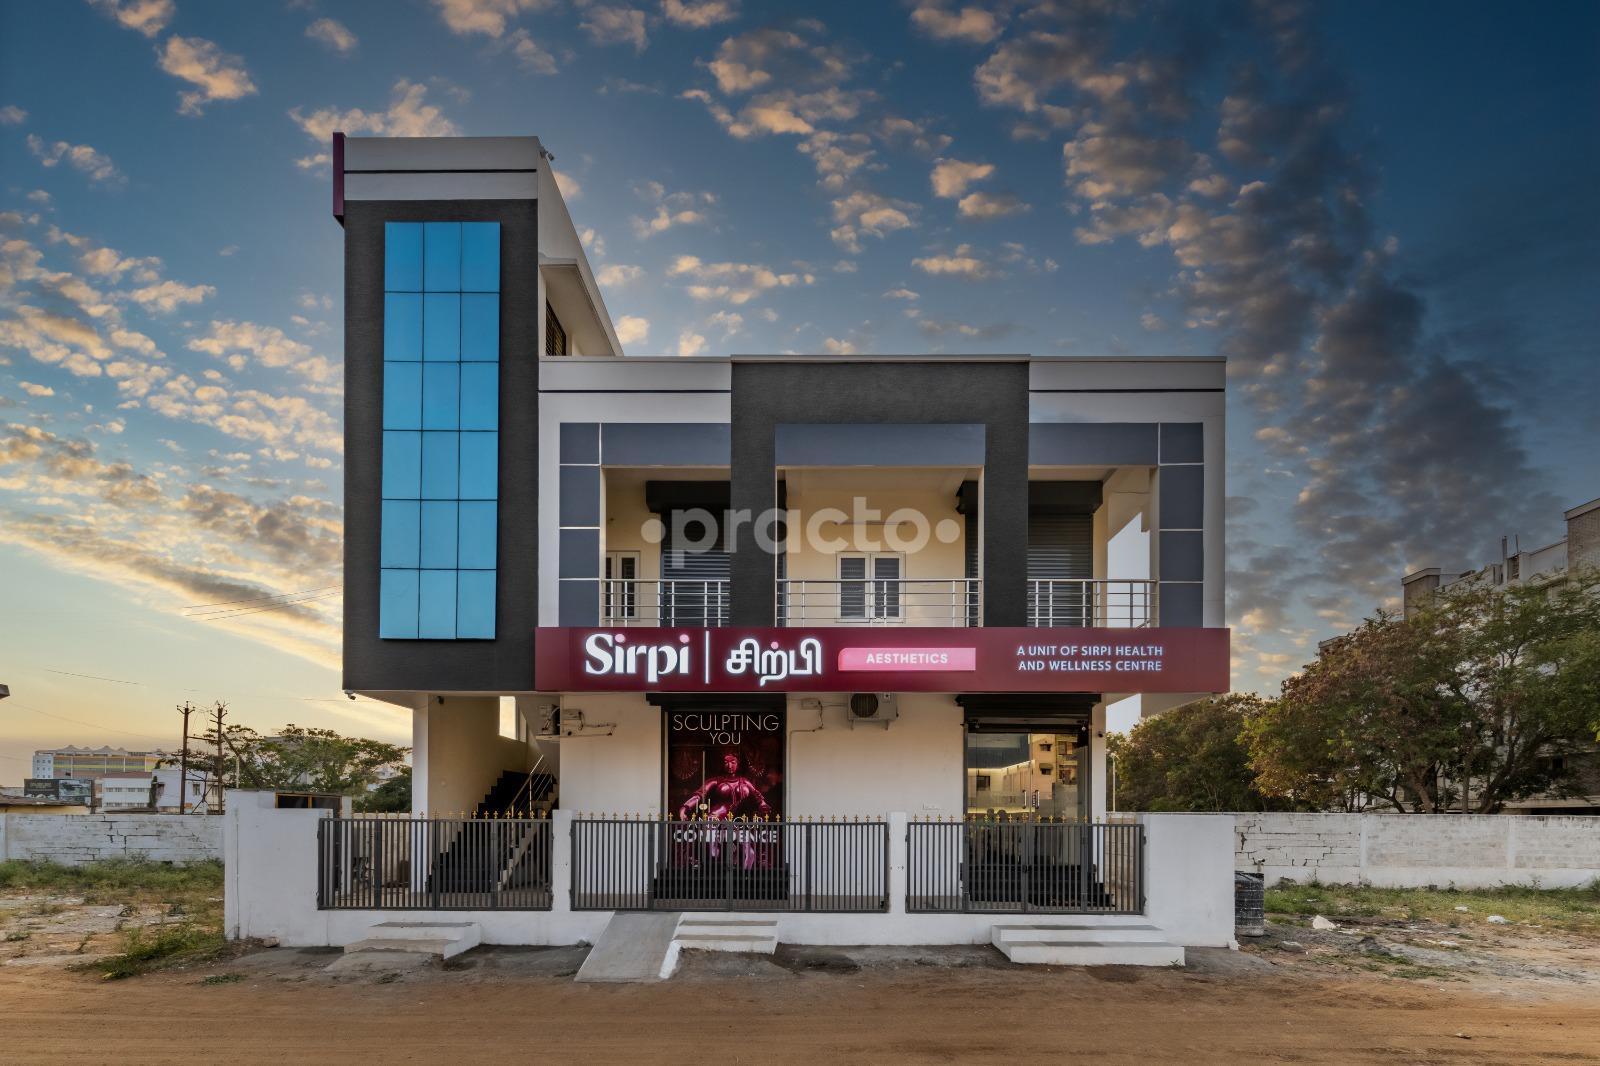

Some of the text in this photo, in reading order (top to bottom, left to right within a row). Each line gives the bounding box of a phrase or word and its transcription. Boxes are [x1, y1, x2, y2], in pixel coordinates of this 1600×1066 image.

[1016, 645, 1163, 656] A UNIT OF SIRPI HEALTH
[585, 633, 690, 683] Sirpi
[726, 638, 822, 687] சிற்பி
[866, 652, 949, 665] AESTHETICS
[1018, 660, 1162, 671] AND WELLNESS CENTRE
[673, 714, 780, 731] SCULPTING
[709, 732, 742, 745] YOU
